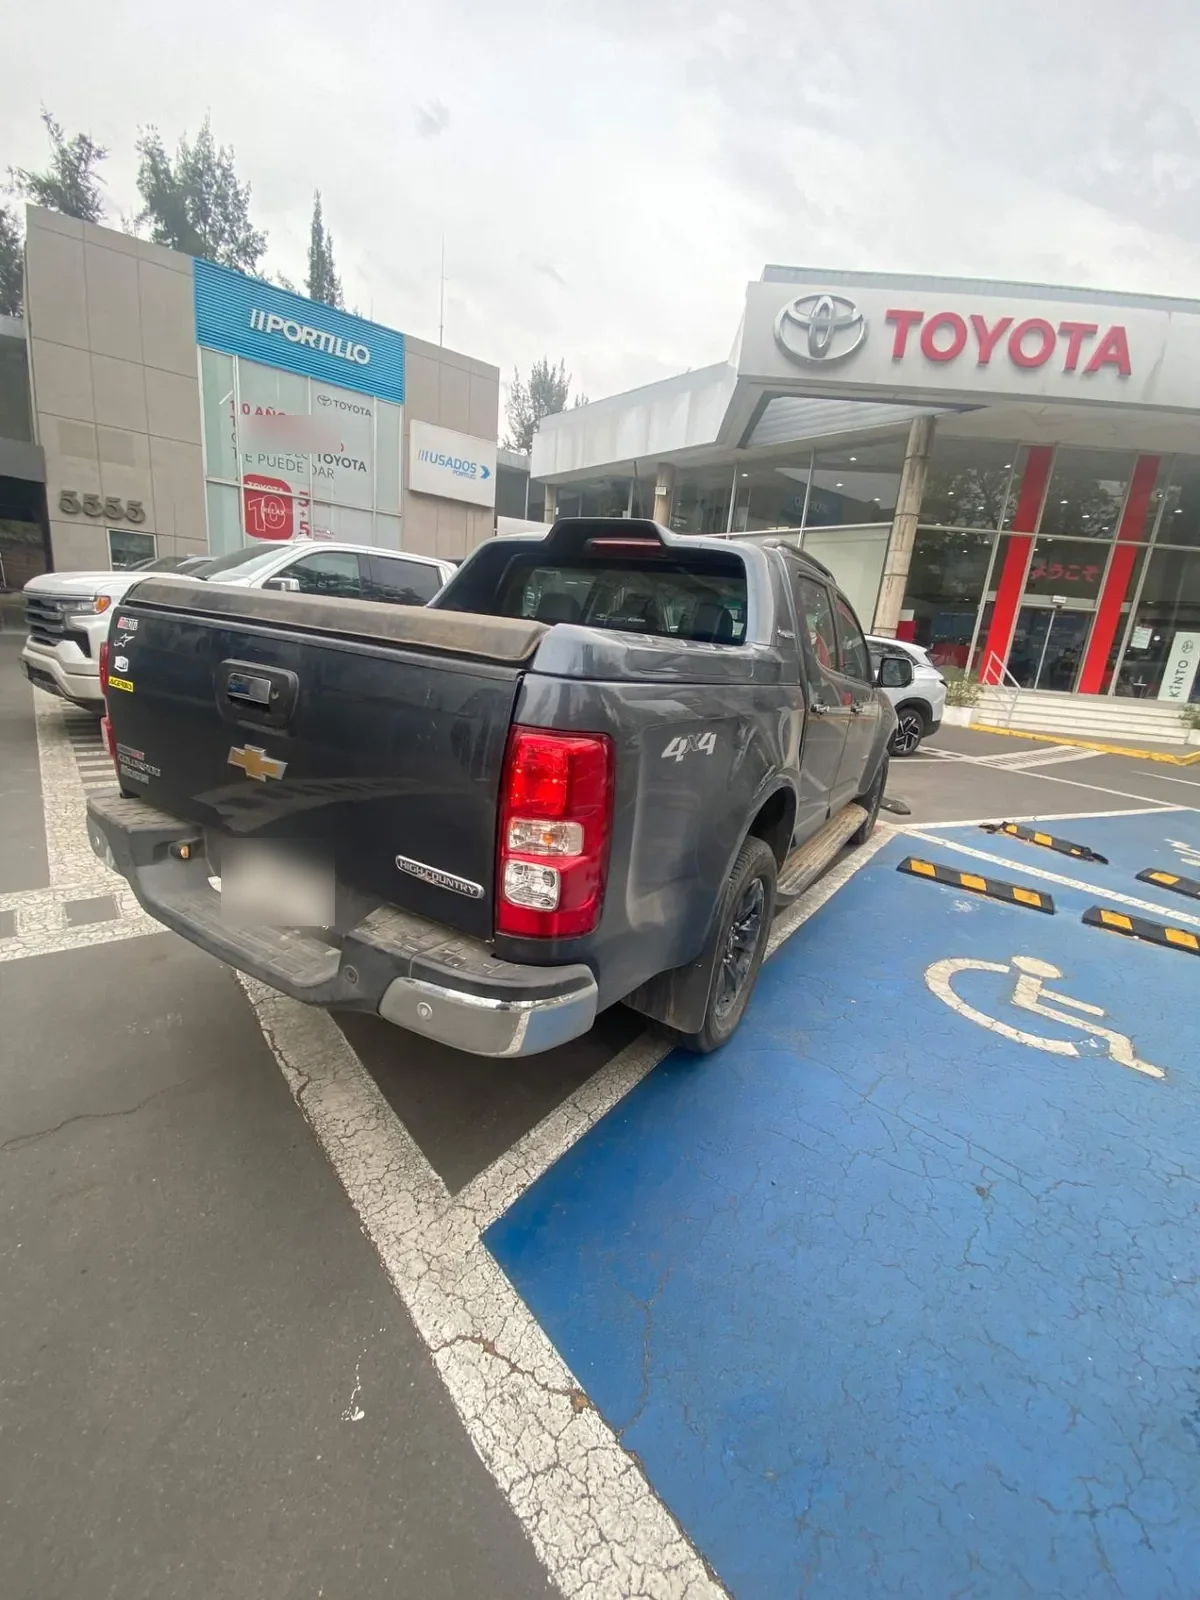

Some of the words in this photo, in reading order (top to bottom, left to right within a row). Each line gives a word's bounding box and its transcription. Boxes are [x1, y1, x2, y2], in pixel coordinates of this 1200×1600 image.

[885, 308, 1132, 376] TOYOTA
[334, 400, 372, 417] TOYOTA
[258, 454, 304, 473] PUEDE
[317, 454, 367, 472] TOYOTA
[429, 451, 477, 473] USADOS
[59, 490, 146, 524] 5555
[400, 860, 423, 876] HIGH
[425, 870, 476, 894] COUNTRY
